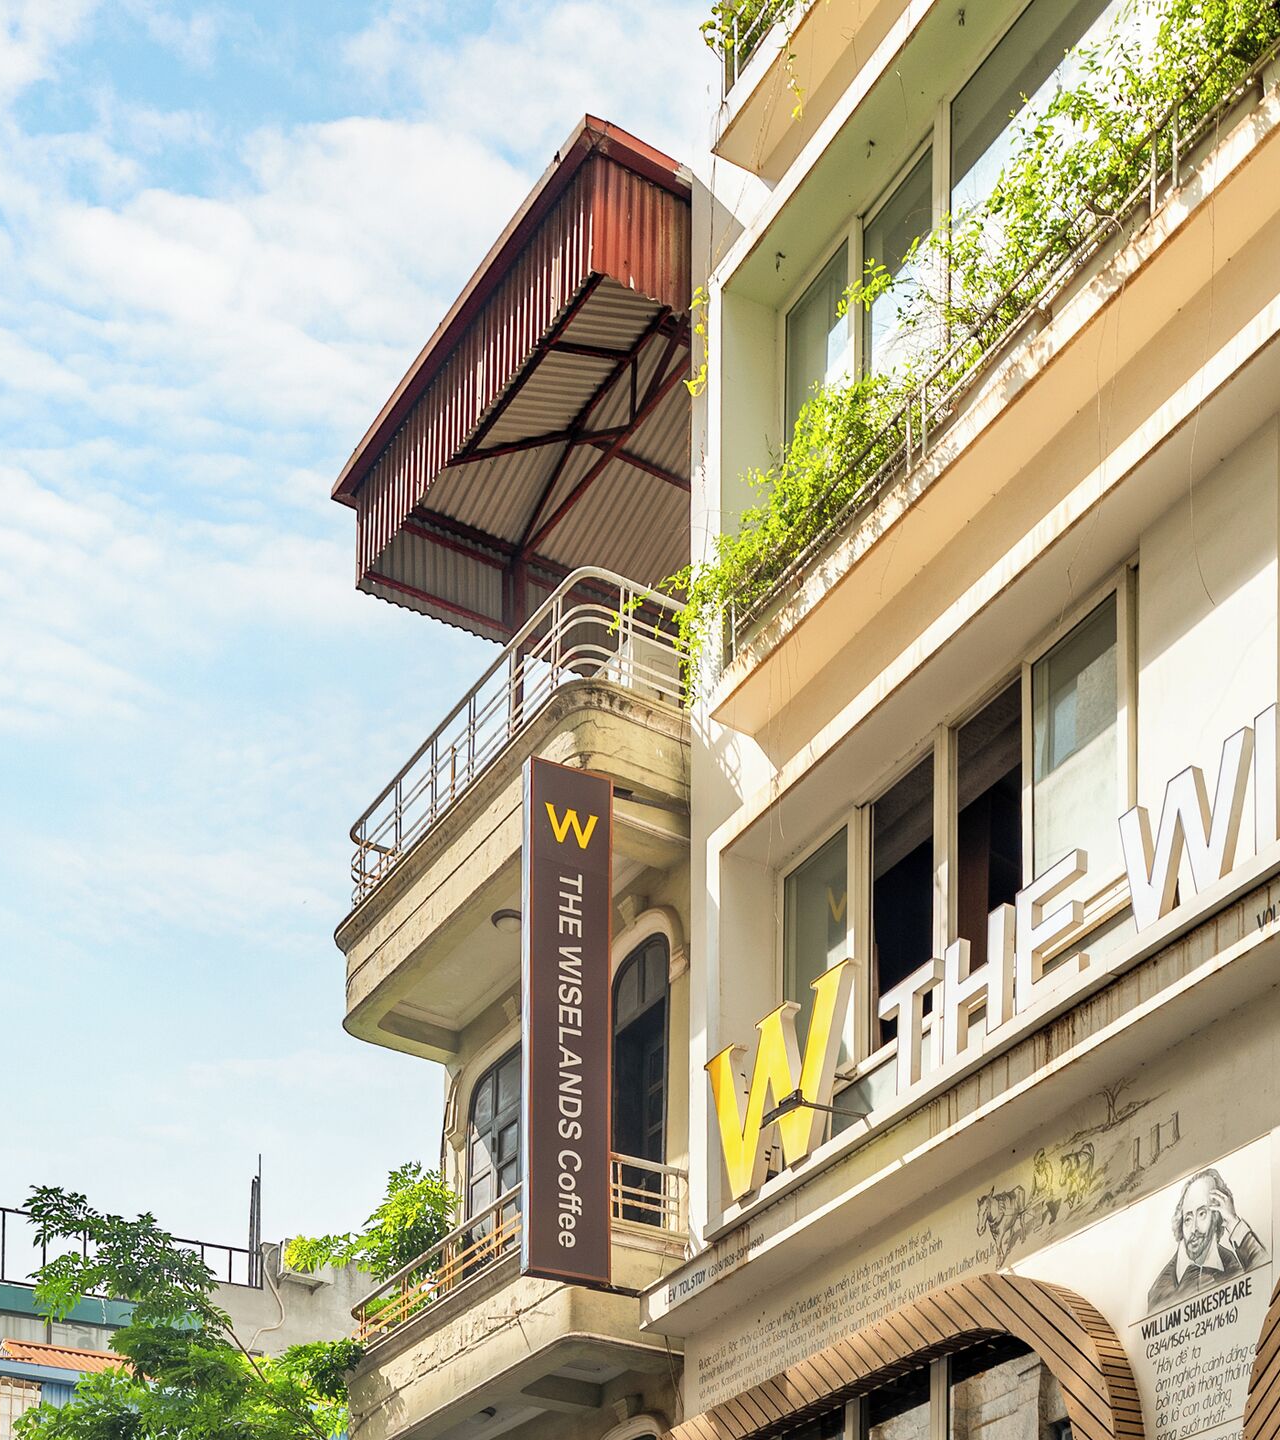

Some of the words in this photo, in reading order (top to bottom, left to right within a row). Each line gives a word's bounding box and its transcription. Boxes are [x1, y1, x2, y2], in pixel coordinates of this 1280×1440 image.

[544, 802, 599, 849] W
[558, 873, 584, 938] THE
[558, 944, 584, 1141] WISELANDS
[704, 957, 857, 1208] W
[878, 848, 1089, 1096] THE
[558, 1149, 584, 1250] Coffee
[678, 1270, 706, 1294] TOLSTOY
[1141, 1308, 1181, 1341] WILLIAM
[1184, 1277, 1252, 1327] SHAKESPEARE
